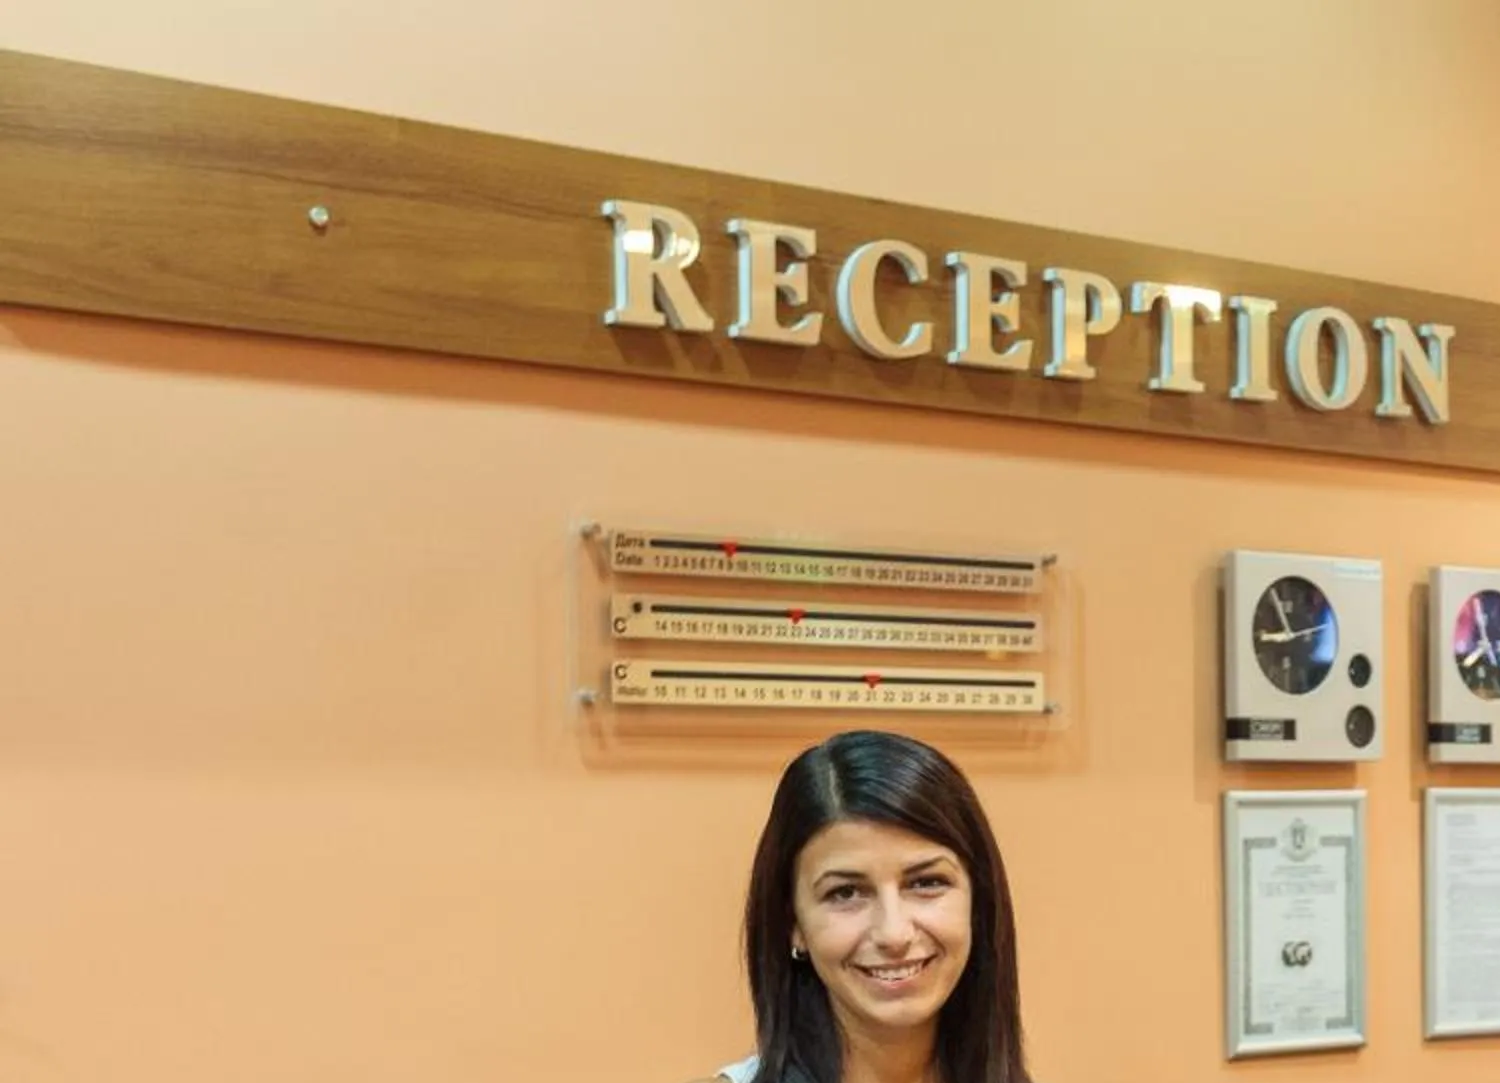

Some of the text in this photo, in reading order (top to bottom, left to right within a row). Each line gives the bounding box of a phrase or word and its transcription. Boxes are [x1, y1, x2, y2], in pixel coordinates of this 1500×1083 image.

[601, 199, 1456, 424] RECEPTION
[615, 552, 643, 566] Date
[654, 684, 667, 697] 10
[675, 685, 686, 697] 11
[694, 685, 707, 698] 12
[714, 686, 726, 698] 13
[733, 686, 747, 699] 14
[753, 687, 766, 699] 15
[772, 687, 785, 700] 16
[791, 688, 803, 700] 17
[810, 688, 822, 701] 18
[829, 689, 841, 701] 19
[847, 689, 859, 701] 20
[865, 689, 877, 702] 21
[883, 690, 895, 702] 22
